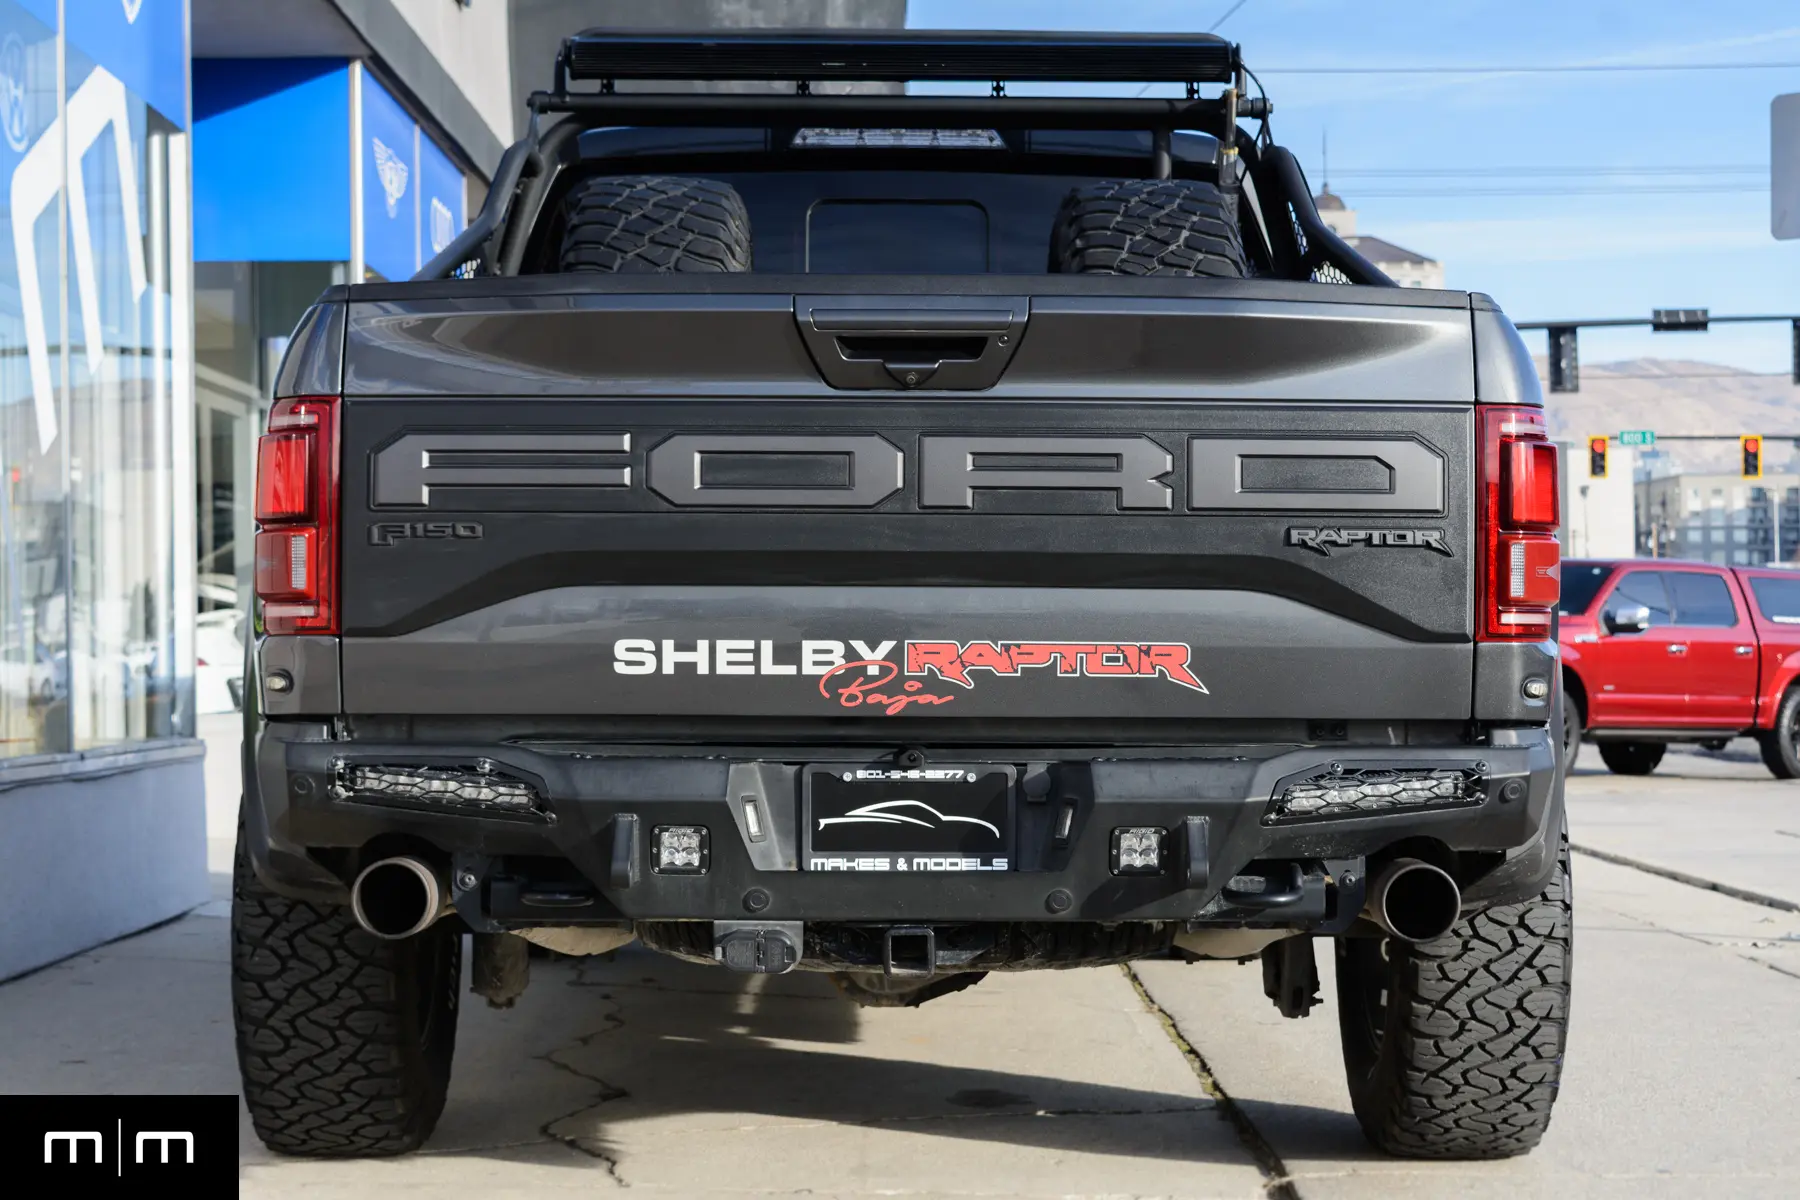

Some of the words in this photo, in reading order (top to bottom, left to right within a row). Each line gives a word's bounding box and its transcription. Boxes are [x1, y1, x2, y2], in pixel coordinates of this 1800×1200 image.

[368, 431, 1446, 512] FORD
[1287, 526, 1454, 557] RAPTOR
[613, 639, 897, 675] SHELBY
[904, 639, 1209, 694] RAPTOR
[819, 659, 954, 715] Baja
[810, 858, 890, 871] MAKES
[896, 858, 908, 871] &
[913, 858, 1008, 871] MODELS
